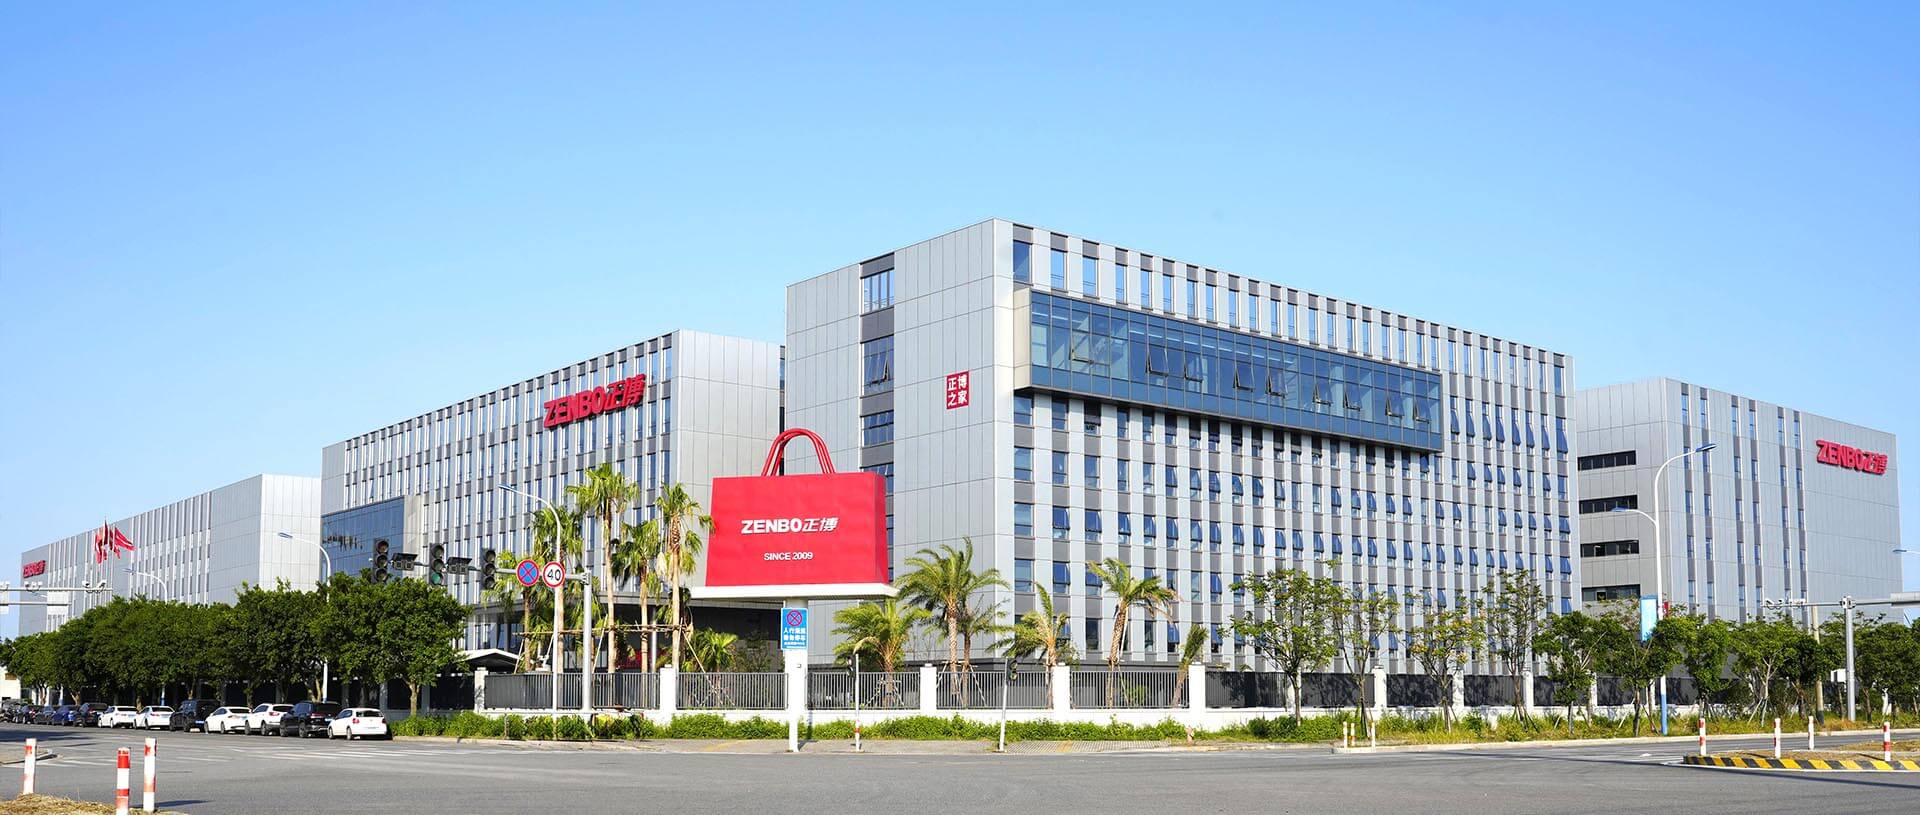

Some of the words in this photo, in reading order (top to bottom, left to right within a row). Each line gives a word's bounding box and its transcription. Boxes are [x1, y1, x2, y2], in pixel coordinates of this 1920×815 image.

[947, 374, 968, 391] 正博
[947, 390, 968, 407] 之家
[741, 517, 839, 534] ZENBO正博
[764, 551, 791, 561] SINCE
[792, 551, 814, 560] 2009
[547, 569, 562, 581] 40
